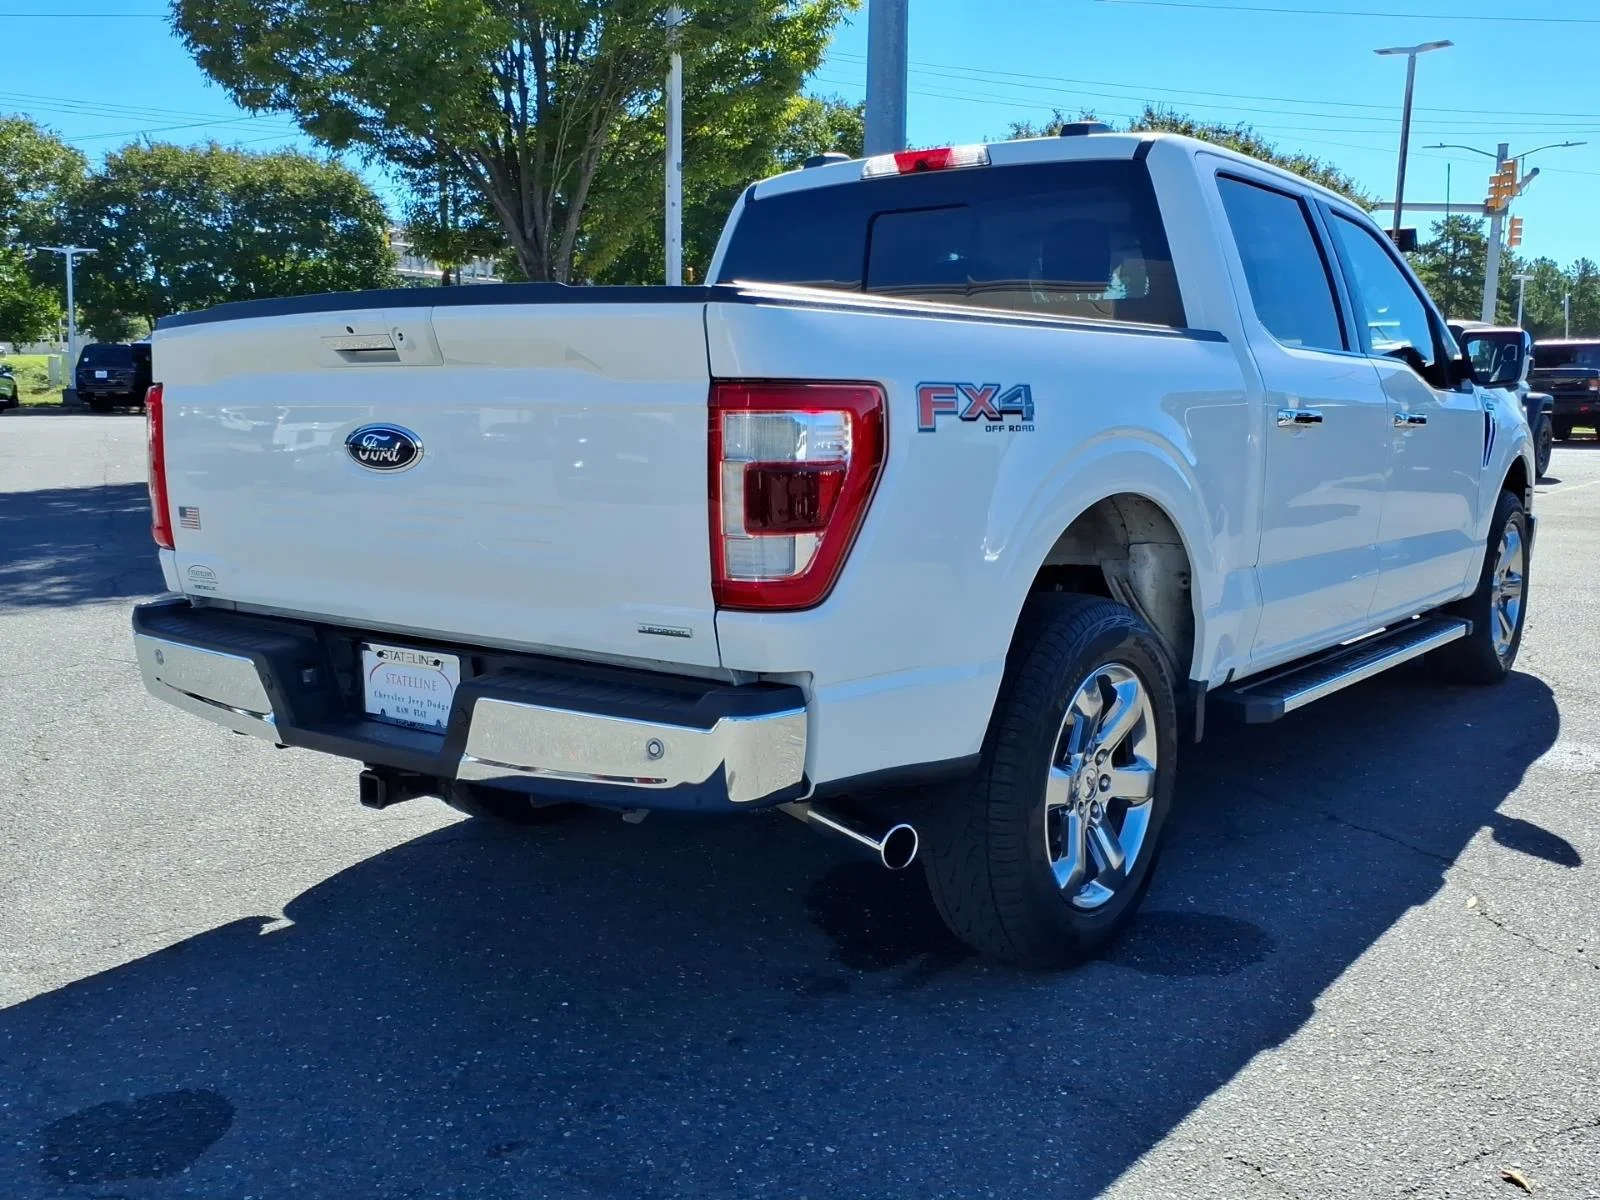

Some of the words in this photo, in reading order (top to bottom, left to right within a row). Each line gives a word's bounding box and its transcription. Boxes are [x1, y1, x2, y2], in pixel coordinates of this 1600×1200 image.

[916, 381, 1034, 433] FX4
[985, 425, 1005, 433] OFF
[1009, 425, 1035, 433] ROAD
[359, 434, 401, 462] Ford
[382, 649, 436, 667] STATELINE
[386, 674, 438, 691] STATELINE
[374, 690, 405, 702] Chrysler
[408, 696, 424, 707] Jeep
[427, 699, 449, 711] Dodge
